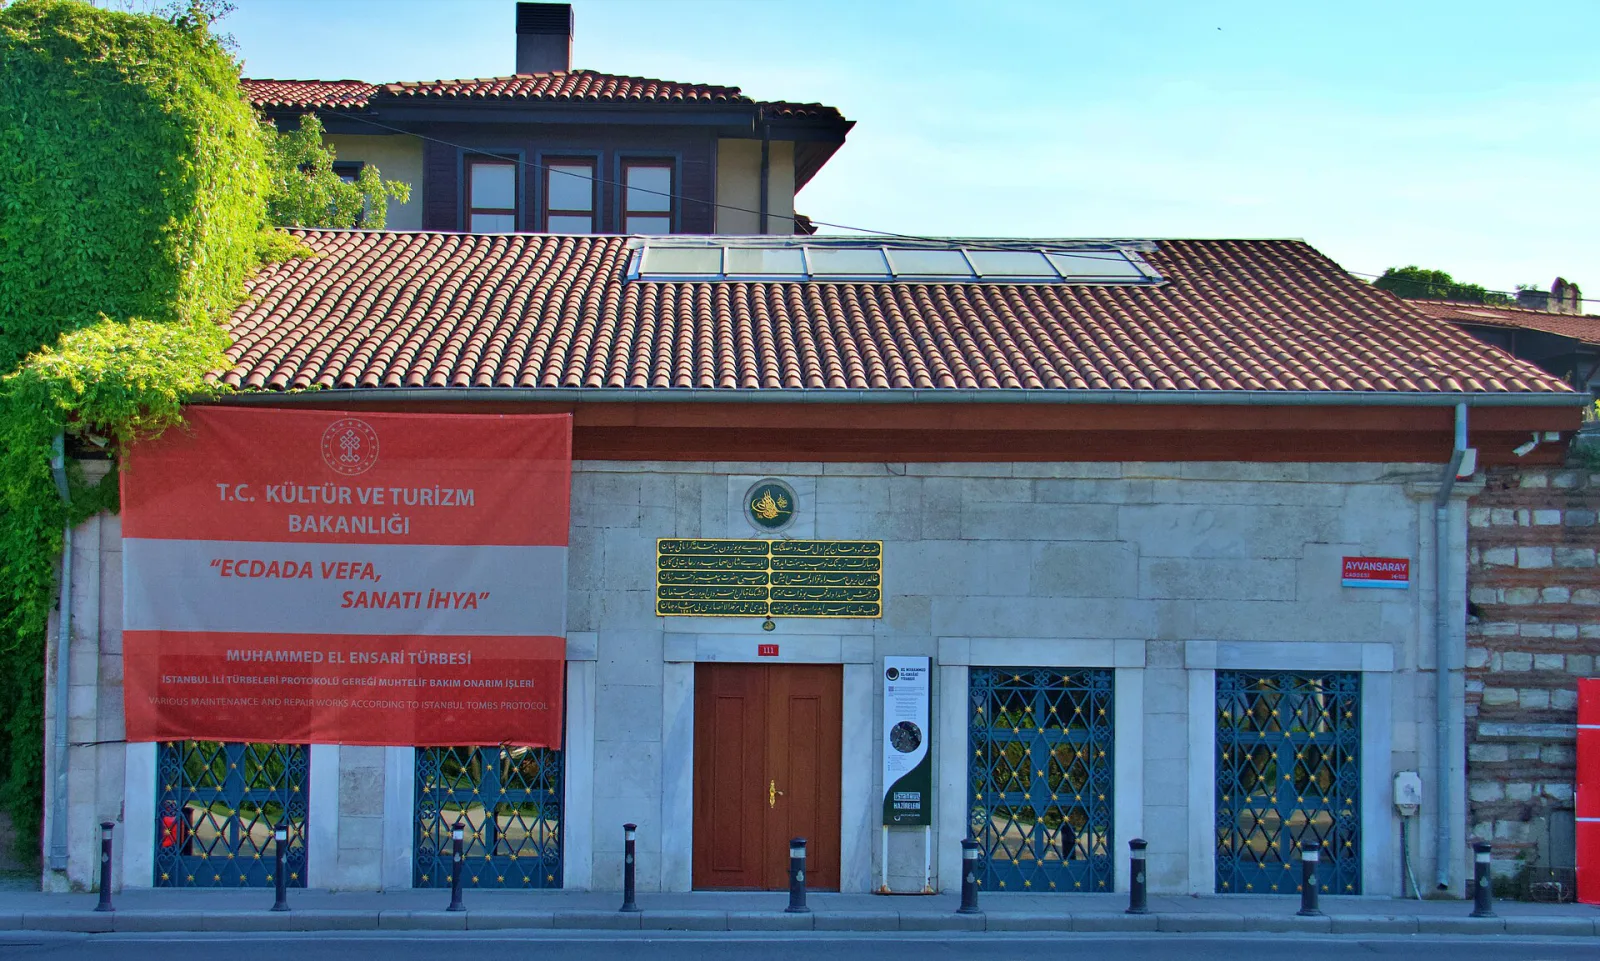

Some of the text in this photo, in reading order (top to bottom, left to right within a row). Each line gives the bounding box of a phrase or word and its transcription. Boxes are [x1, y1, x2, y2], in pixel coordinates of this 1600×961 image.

[217, 481, 475, 506] T.C. KÜLTÜR VE TURİZM
[289, 513, 409, 535] BAKANLIĞI
[210, 559, 382, 583] “ECDADA VEFA,
[1345, 561, 1407, 571] AYVANSARAY
[341, 588, 490, 610] SANATI İHYA”
[227, 649, 472, 665] MUHAMMED EL ENSARİ TÜRBESİ
[227, 674, 278, 684] TÜRBELERİ
[281, 675, 339, 686] PROTOKOLÜ
[342, 676, 376, 686] GEREĞİ
[379, 678, 427, 688] MUHTELİF
[430, 679, 460, 688] BAKIM
[463, 679, 503, 688] ONARIM
[505, 678, 535, 689] İŞLERİ
[149, 696, 549, 710] VARIOUS MAINTENANCE AND REPAIR WORKS ACCORDING TO ISTANBUL TOMBS PROTOCOL
